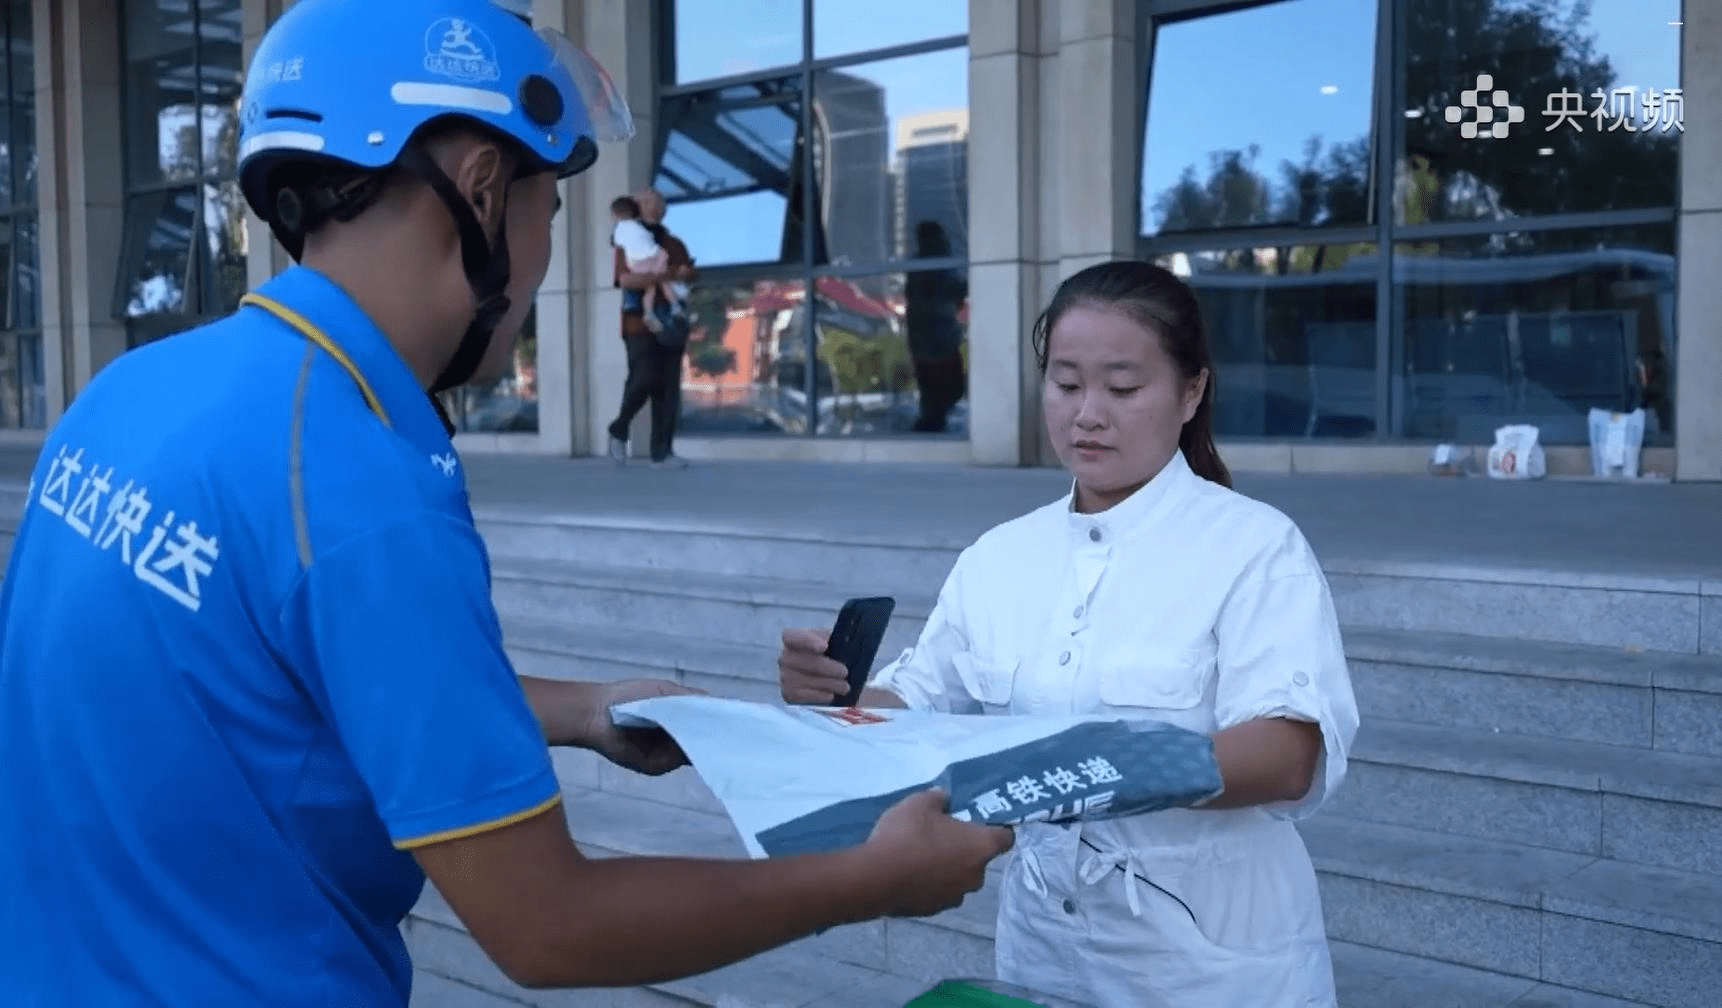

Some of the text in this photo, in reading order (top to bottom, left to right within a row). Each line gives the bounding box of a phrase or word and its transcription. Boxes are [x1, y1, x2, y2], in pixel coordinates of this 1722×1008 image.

[39, 443, 220, 613] 达达快送
[972, 755, 1123, 819] 高铁快递
